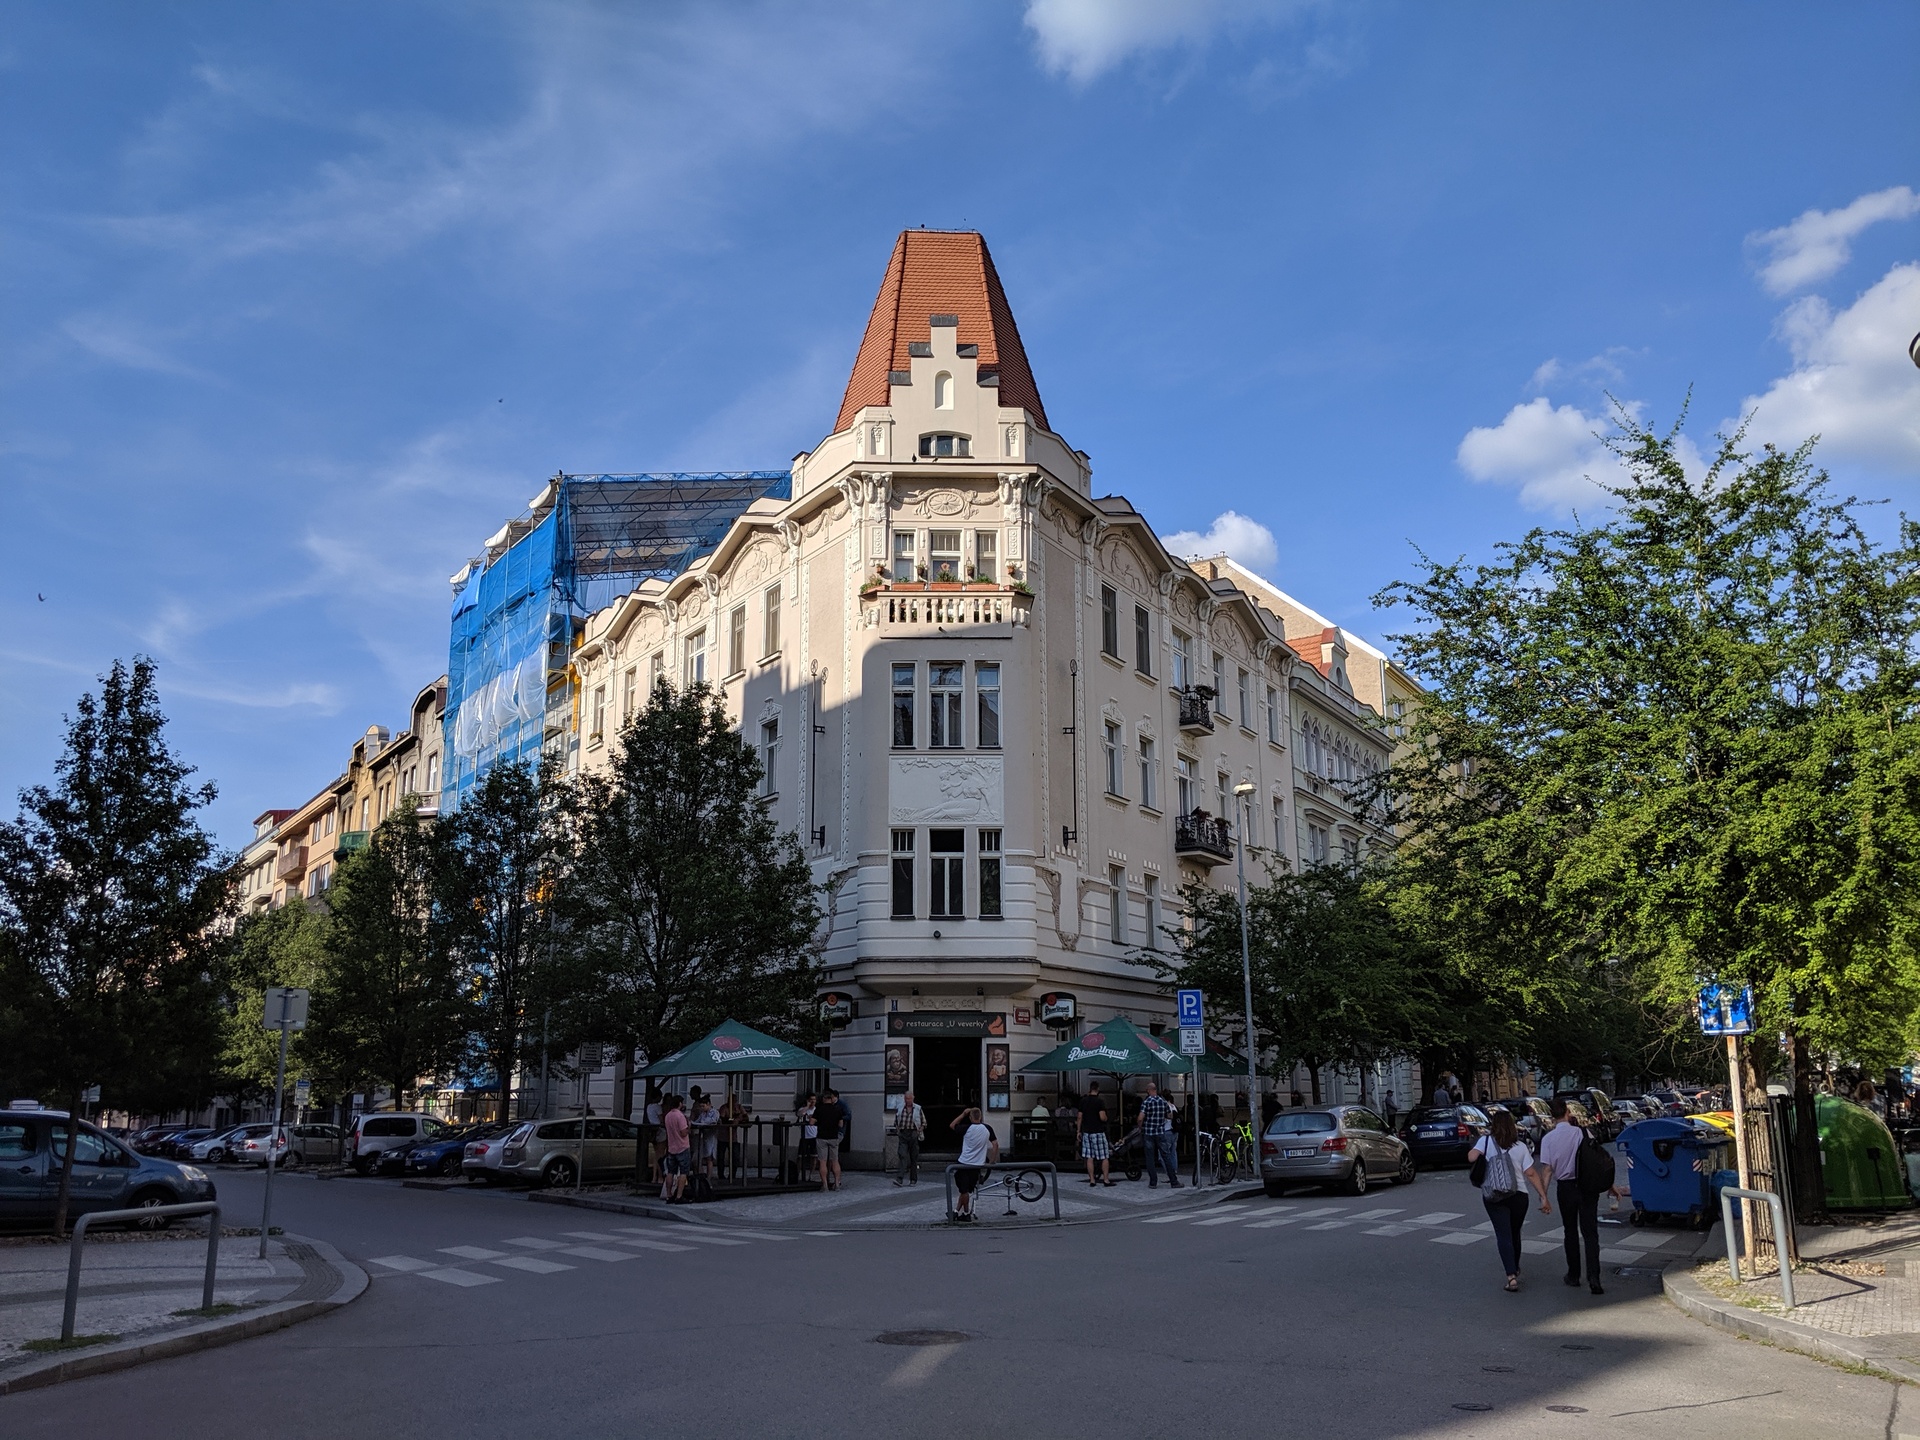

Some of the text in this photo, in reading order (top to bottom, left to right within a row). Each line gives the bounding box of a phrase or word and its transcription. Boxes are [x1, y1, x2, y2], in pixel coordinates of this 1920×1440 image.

[1183, 994, 1196, 1016] P
[710, 1047, 781, 1064] Pilsner Urquell
[1067, 1046, 1100, 1062] Pilsner
[1099, 1045, 1129, 1060] Urquell
